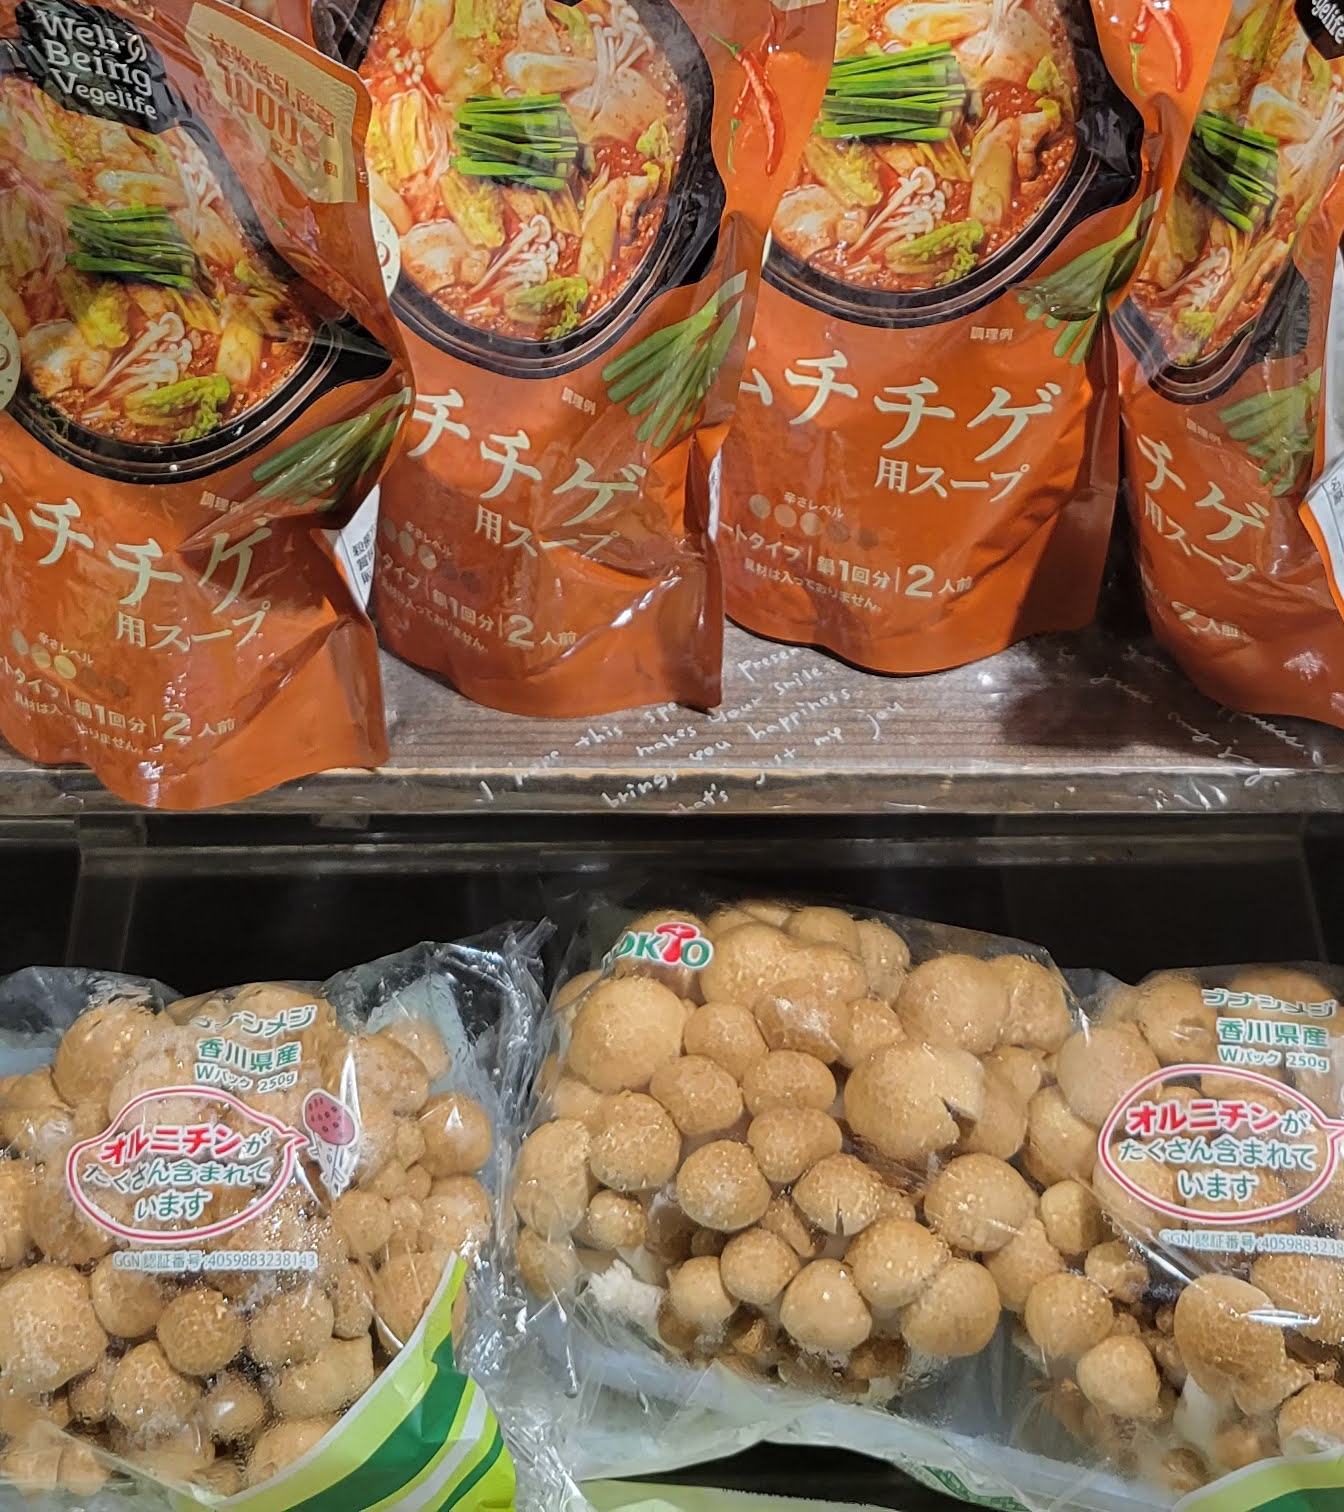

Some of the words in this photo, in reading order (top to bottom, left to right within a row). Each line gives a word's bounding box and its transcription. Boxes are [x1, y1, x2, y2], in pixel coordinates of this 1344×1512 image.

[46, 40, 153, 97] Being
[51, 71, 157, 120] Vegelife
[408, 388, 646, 526] チチゲ
[874, 456, 1030, 502] 用スープ
[783, 491, 845, 520] 辛さレベル
[475, 504, 620, 558] 用スープ
[1144, 498, 1256, 584] 用スープ
[816, 554, 891, 589] 鍋1回分
[115, 600, 272, 653] 用スープ
[433, 589, 494, 632] 鍋1回分
[508, 614, 577, 650] 2人前
[39, 630, 94, 665] 辛さレベル
[74, 697, 147, 734] 鍋1回分
[161, 712, 236, 745] 2人前
[1204, 989, 1336, 1018] ブナシメジ
[1219, 1019, 1329, 1048] 香川県産
[198, 1038, 302, 1072] 香川県産
[1220, 1049, 1280, 1065] Wパック
[1285, 1055, 1329, 1072] 250g
[258, 1071, 299, 1092] 250g
[1127, 1103, 1309, 1134] オルニチンが
[101, 1125, 272, 1166] オルニチンが
[1119, 1137, 1317, 1169] たくさん含まれて
[84, 1160, 271, 1192] たくさん含まれて
[1179, 1173, 1256, 1199] います
[136, 1191, 212, 1221] います
